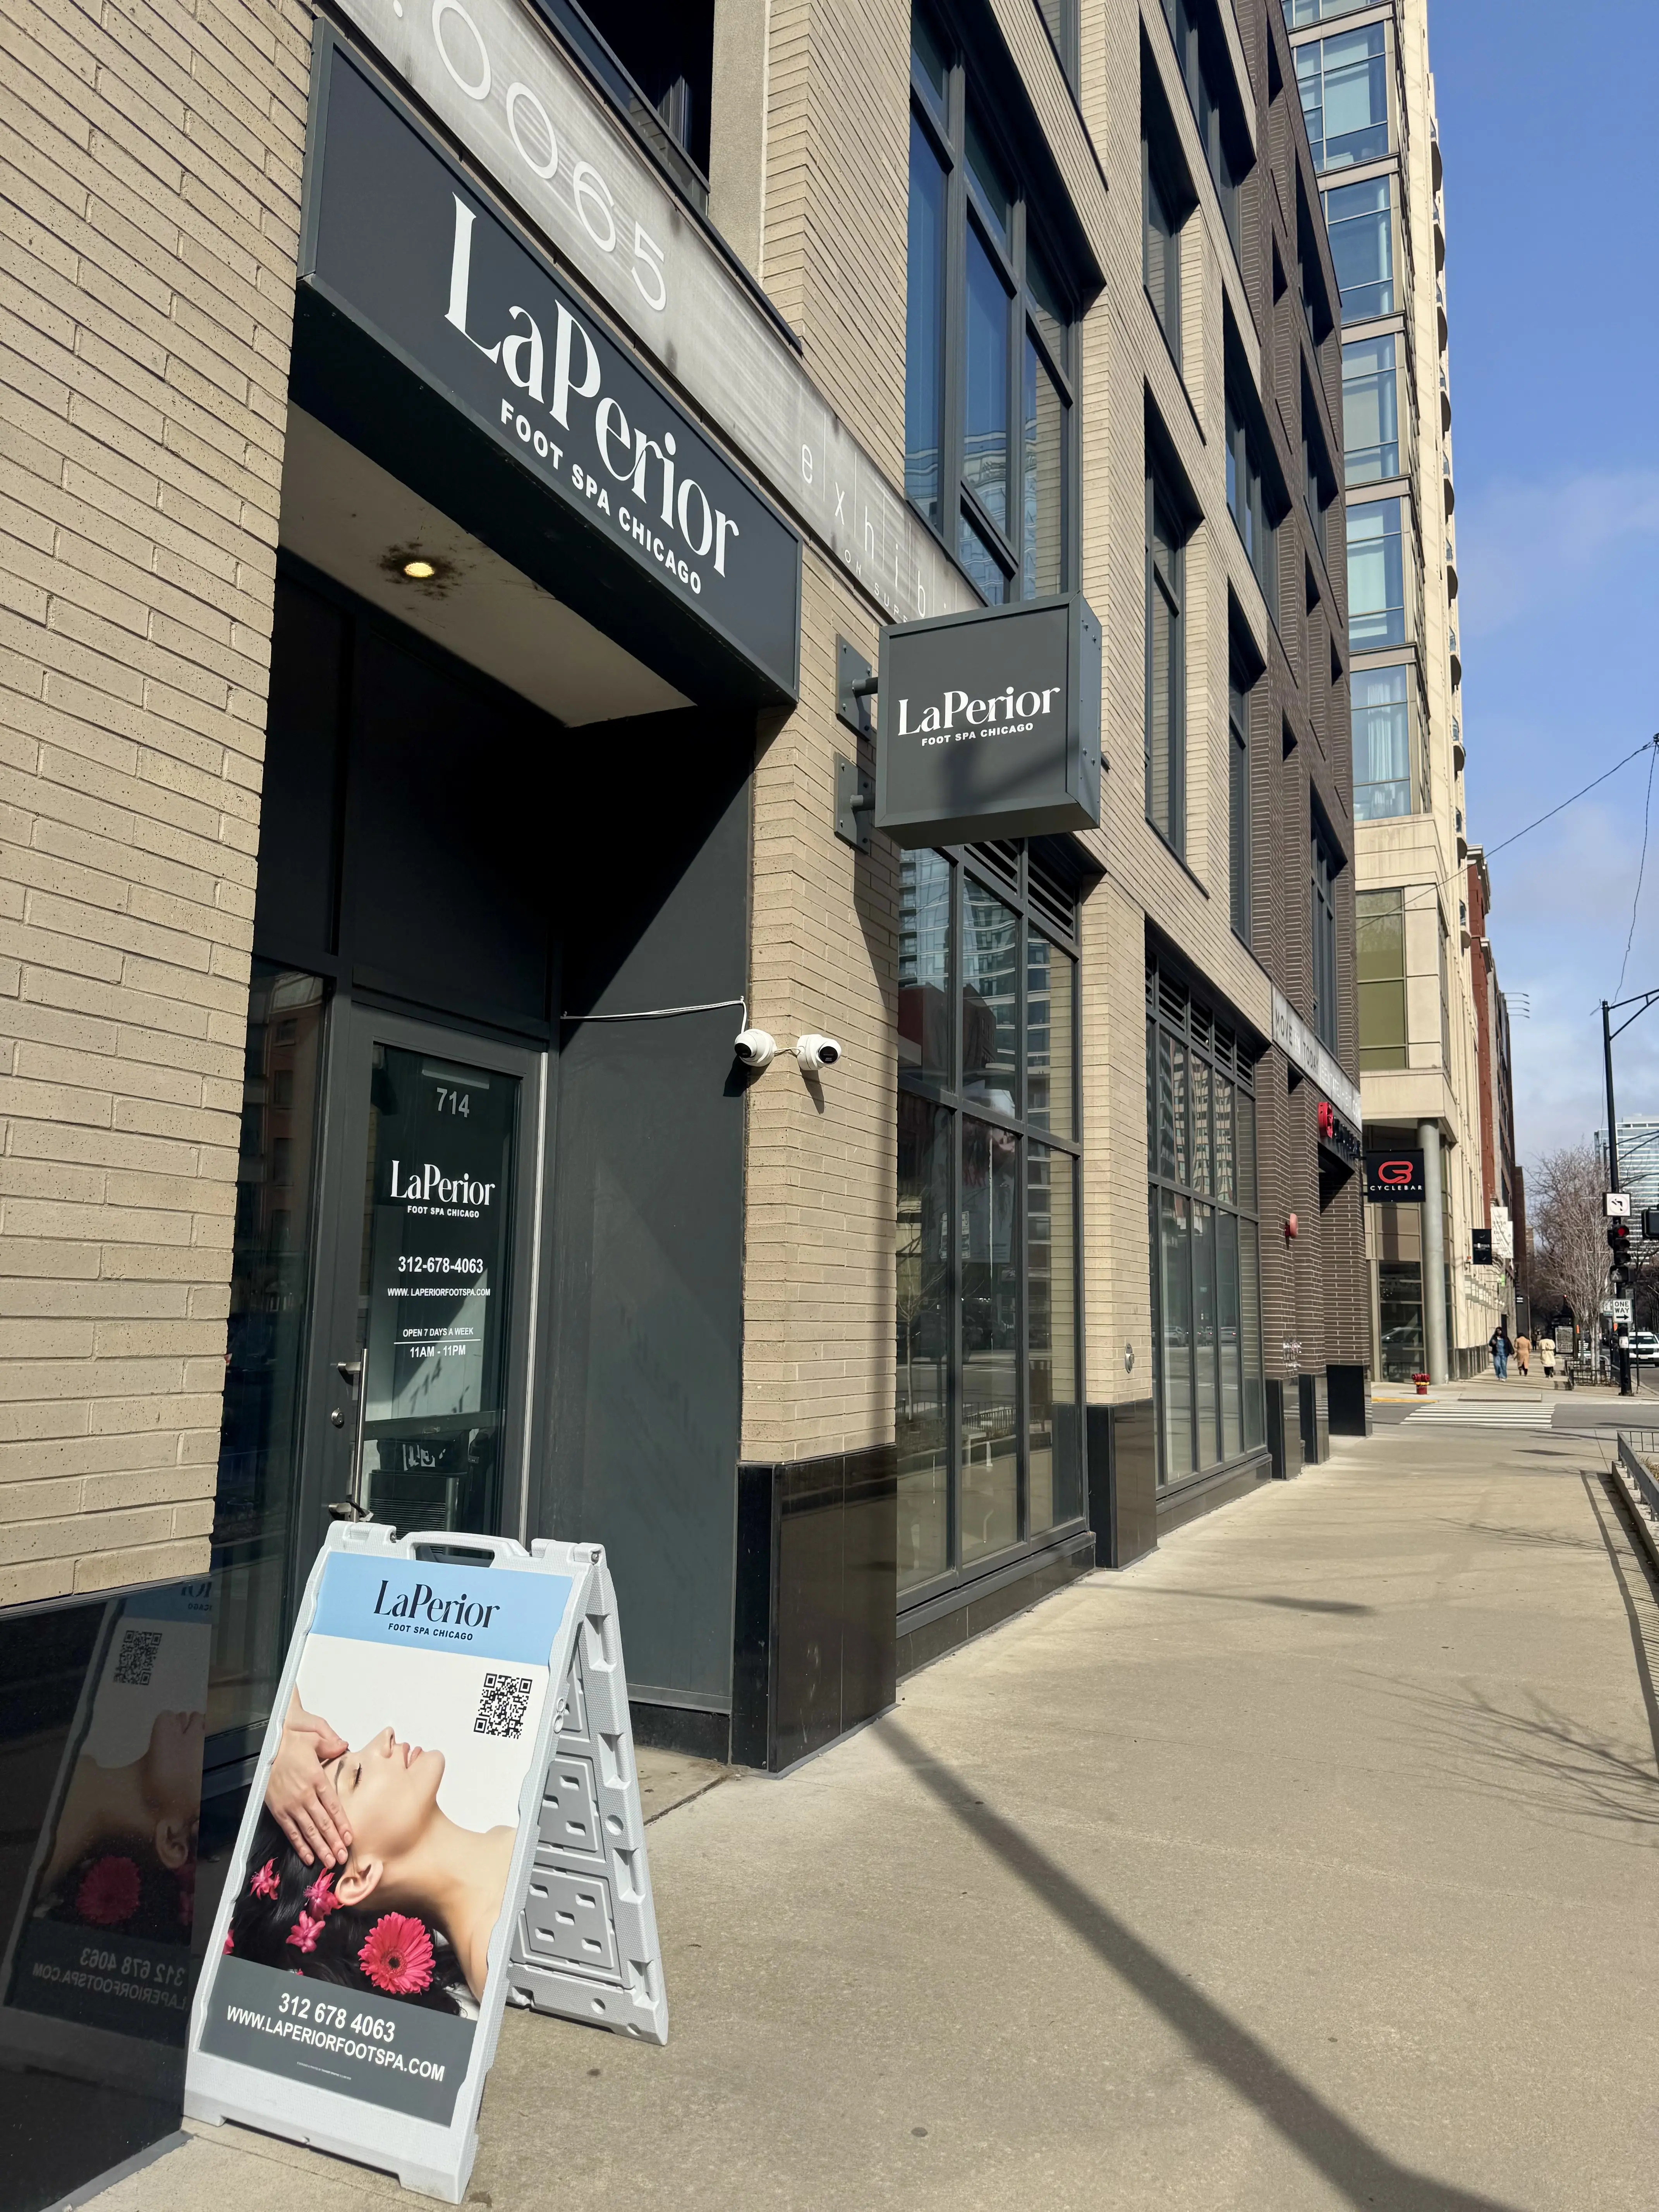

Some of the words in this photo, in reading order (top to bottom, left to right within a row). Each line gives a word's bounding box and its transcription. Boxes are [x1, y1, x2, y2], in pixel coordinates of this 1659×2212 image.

[444, 192, 739, 578] LaPerior
[501, 398, 563, 470] FOOT
[571, 464, 610, 516] SPA
[618, 507, 701, 594] CHICAGO
[844, 549, 861, 577] ON
[898, 686, 1061, 737] LaPerior
[922, 735, 951, 747] FOOT
[955, 731, 976, 742] SPA
[980, 723, 1034, 738] CHICAGO
[1275, 1008, 1293, 1047] MOVE
[1303, 1041, 1319, 1077] TODAY
[436, 1087, 470, 1118] 714
[390, 1160, 496, 1206] LaPerior
[407, 1205, 428, 1214] FOOT
[430, 1207, 445, 1216] SPA
[447, 1208, 479, 1218] CHICAGO
[398, 1256, 483, 1273] 312-678-4063
[403, 1329, 422, 1337] OPEN
[429, 1328, 448, 1336] DAYS
[455, 1327, 474, 1335] WEEK
[410, 1346, 434, 1358] 11AM
[443, 1345, 466, 1356] 11PM
[373, 1580, 500, 1628] LaPerior
[388, 1623, 411, 1632] FOOT
[414, 1626, 429, 1635] SPA
[433, 1629, 473, 1641] CHICAGO
[278, 1992, 311, 2019] 312
[314, 2002, 347, 2029] 678
[350, 2013, 395, 2042] 4063
[227, 2005, 446, 2082] WWW.LAPERIORFOOTSPA.COM
